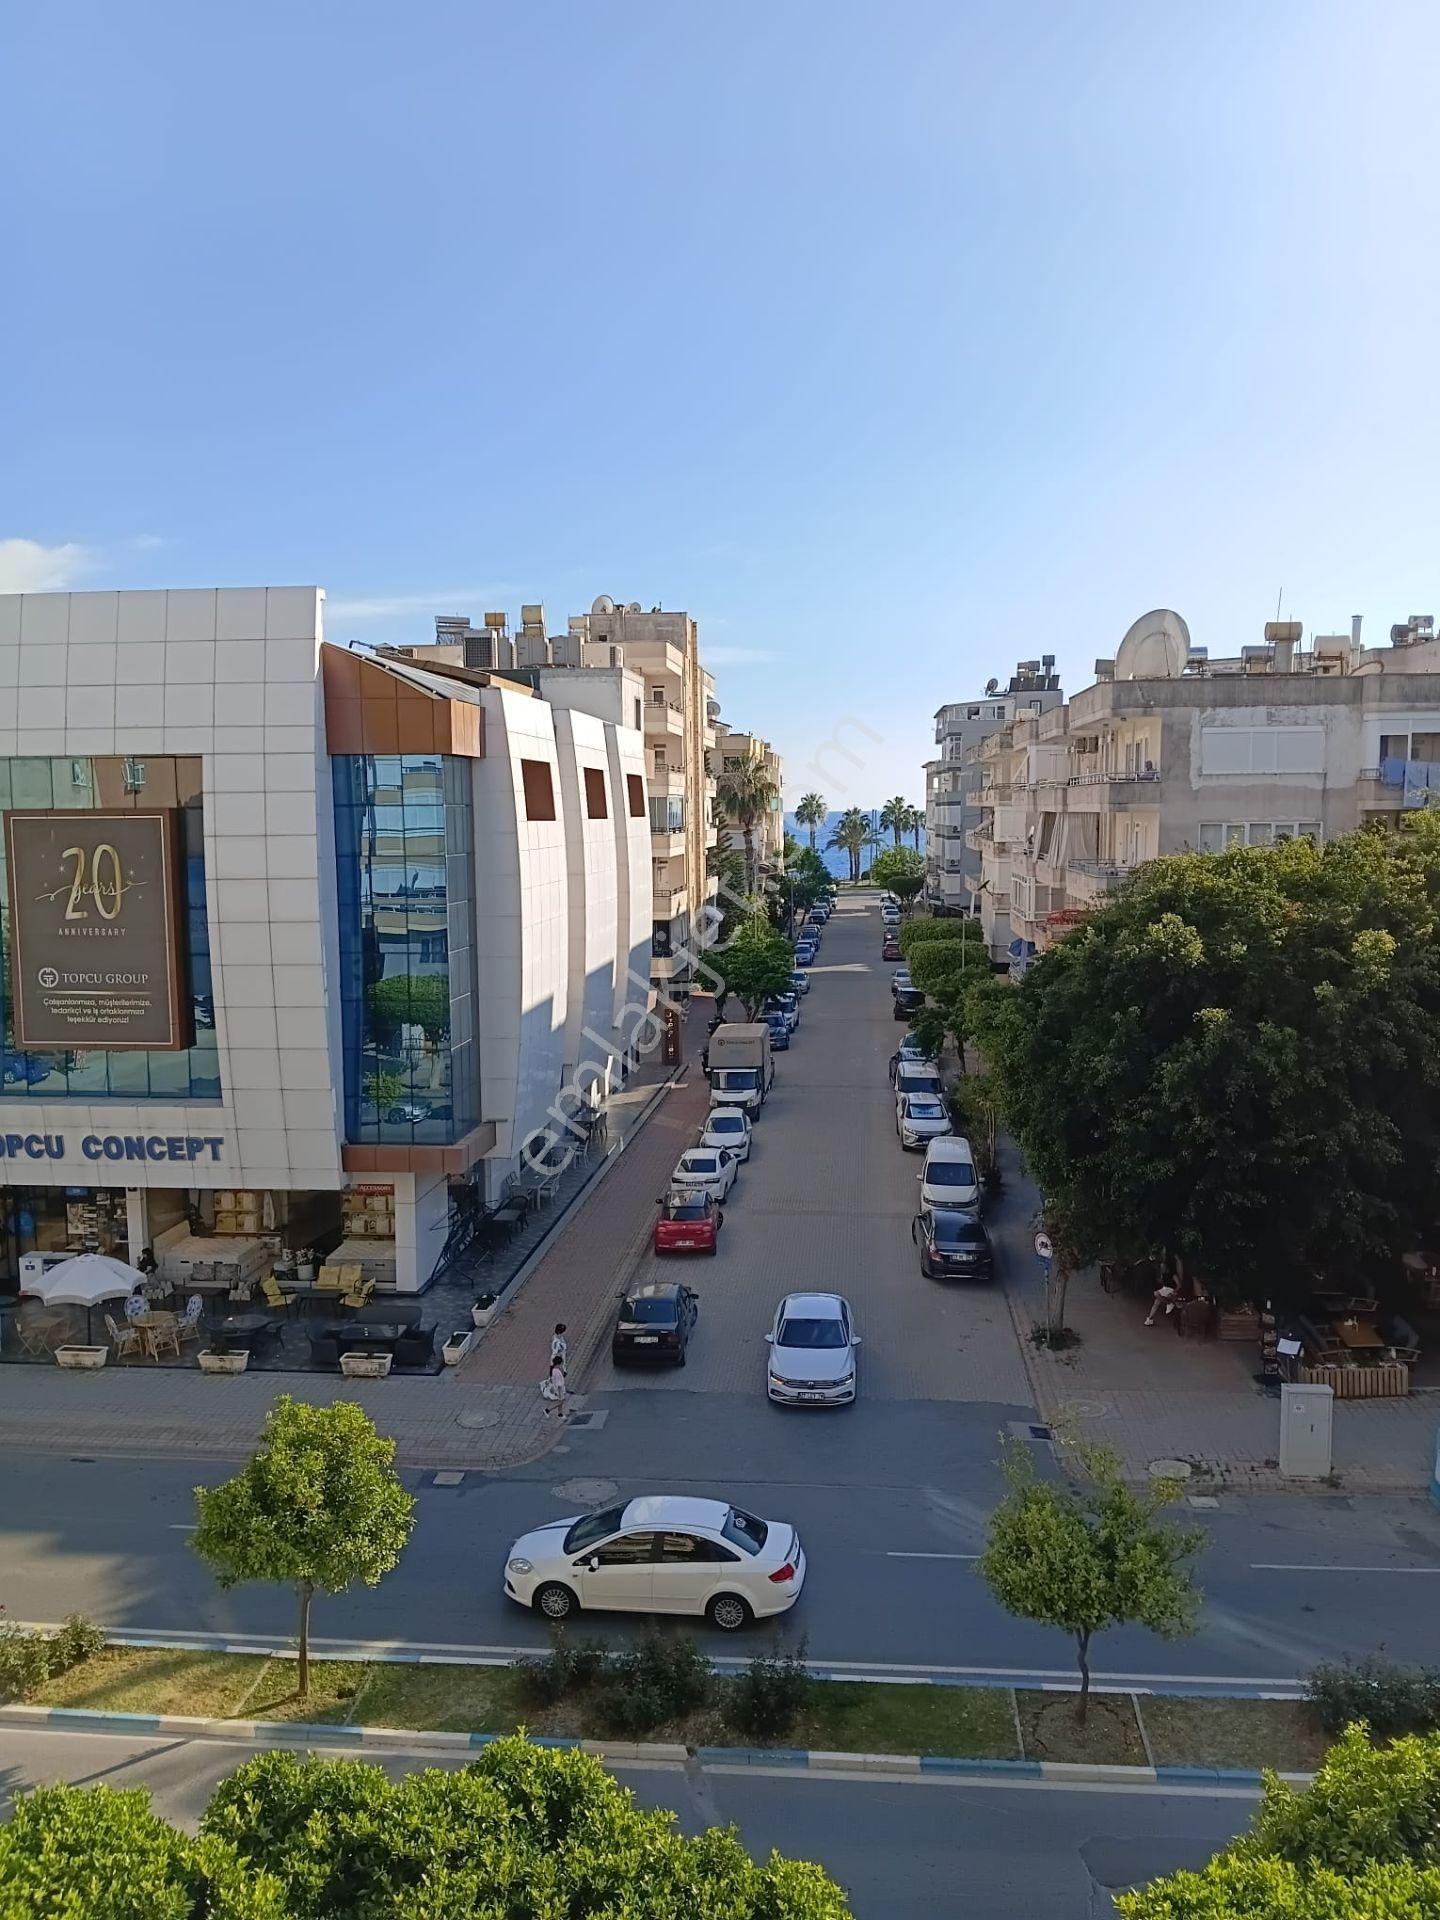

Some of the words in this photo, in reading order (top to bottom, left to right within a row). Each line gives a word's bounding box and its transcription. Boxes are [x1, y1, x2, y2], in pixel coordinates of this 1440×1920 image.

[62, 844, 121, 920] 20
[58, 927, 127, 937] ANNIVERSARY
[61, 973, 102, 984] TOPCU
[105, 973, 149, 984] GROUP
[81, 1134, 224, 1161] CONCEPT
